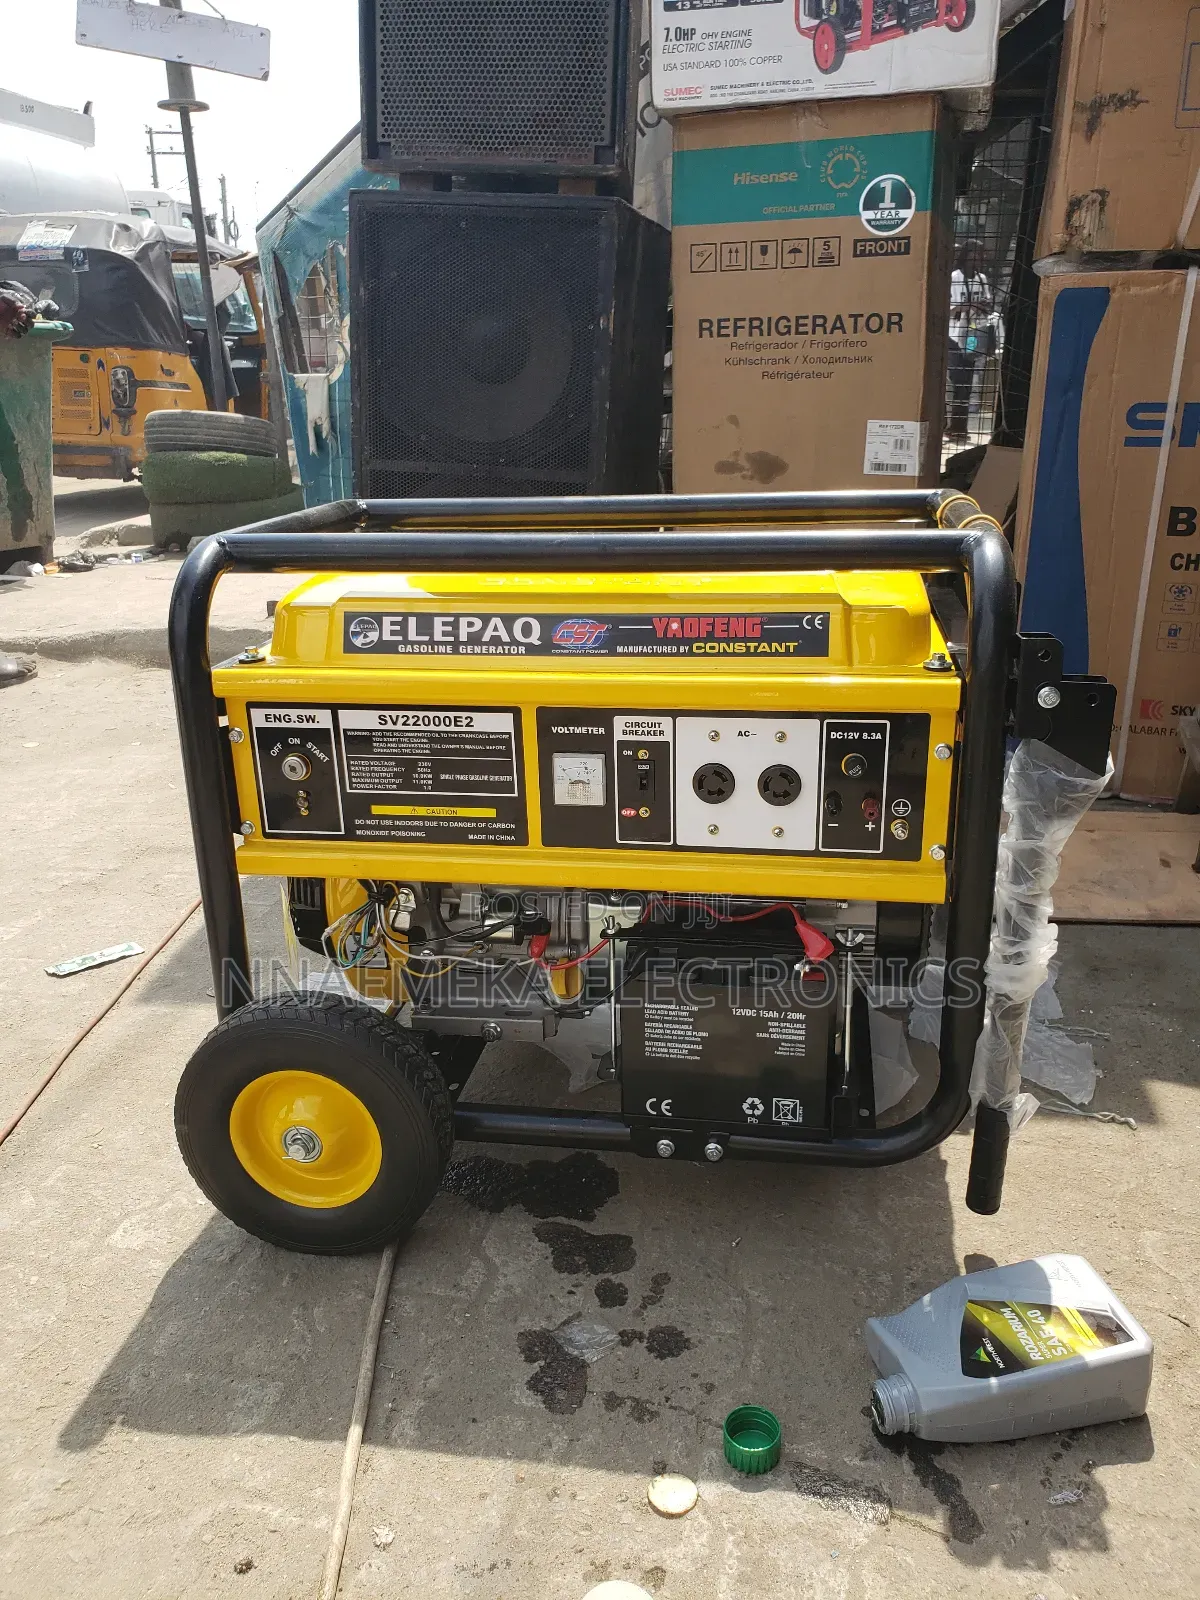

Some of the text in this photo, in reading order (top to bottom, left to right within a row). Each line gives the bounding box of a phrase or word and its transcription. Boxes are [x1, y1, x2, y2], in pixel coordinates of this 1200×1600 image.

[701, 32, 718, 40] OHV
[721, 29, 752, 39] ENGINE
[662, 39, 753, 54] ELECTRIC STARTING
[663, 55, 783, 72] USA STANDARD 100% COPPER
[664, 86, 703, 96] SUMEC
[827, 144, 854, 158] WORLD
[733, 171, 798, 186] Hisense
[878, 180, 896, 208] 1
[762, 204, 836, 214] OFFICIAL PARTNER
[873, 210, 900, 218] YEAR
[822, 240, 831, 251] 5
[856, 240, 908, 254] FRONT
[698, 312, 904, 338] REFRIGERATOR
[730, 341, 798, 351] Refrigerador
[801, 340, 807, 349] /
[724, 355, 873, 366] Kühlschrank / Холодильник
[762, 370, 834, 381] Réfrigérateur
[652, 617, 761, 638] YAOFENG
[803, 615, 824, 630] CE
[382, 616, 542, 646] ELEPAQ
[552, 623, 607, 644] CST
[398, 644, 526, 654] GASOLINE GENERATOR
[616, 645, 677, 653] MANUFACTURED
[692, 642, 798, 653] CONSTANT
[264, 714, 320, 724] ENG.SW.
[378, 714, 474, 728] SV22000E2
[551, 726, 605, 734] VOLTMETER
[622, 729, 665, 737] BREAKER
[862, 732, 882, 740] 8.3A
[270, 742, 282, 756] OFF
[306, 742, 330, 762] START
[732, 1008, 757, 1016] 12VDC
[759, 1010, 778, 1018] 15Ah
[787, 1012, 806, 1020] 20Hr
[646, 1098, 672, 1116] CE
[1000, 1308, 1044, 1360] ROZARIUM
[1026, 1310, 1068, 1356] SAE 40
[982, 1338, 1006, 1368] NORTHWEST
[1037, 1340, 1052, 1359] SUPER
